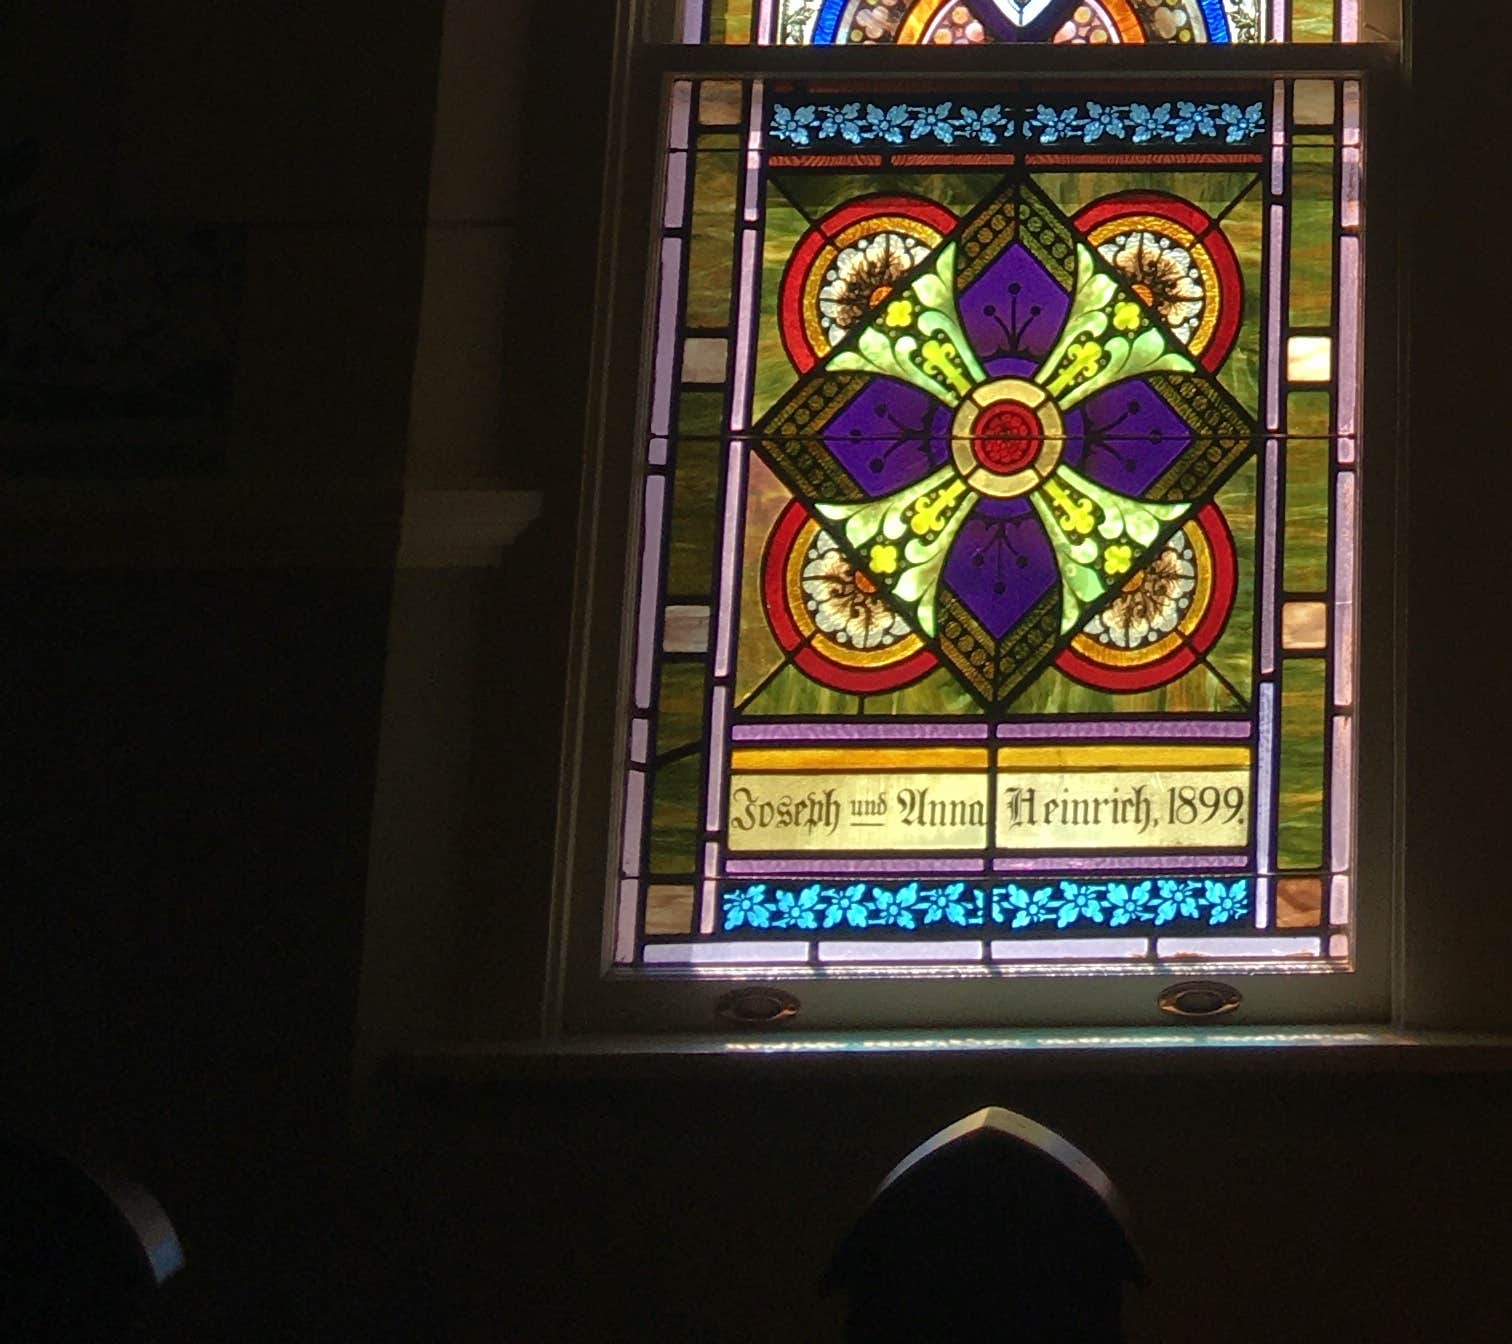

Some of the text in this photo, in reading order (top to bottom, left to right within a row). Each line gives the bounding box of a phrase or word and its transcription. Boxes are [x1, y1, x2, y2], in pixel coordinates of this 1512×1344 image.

[731, 785, 1245, 836] Joseph und Anna Heinrich, 1899.
